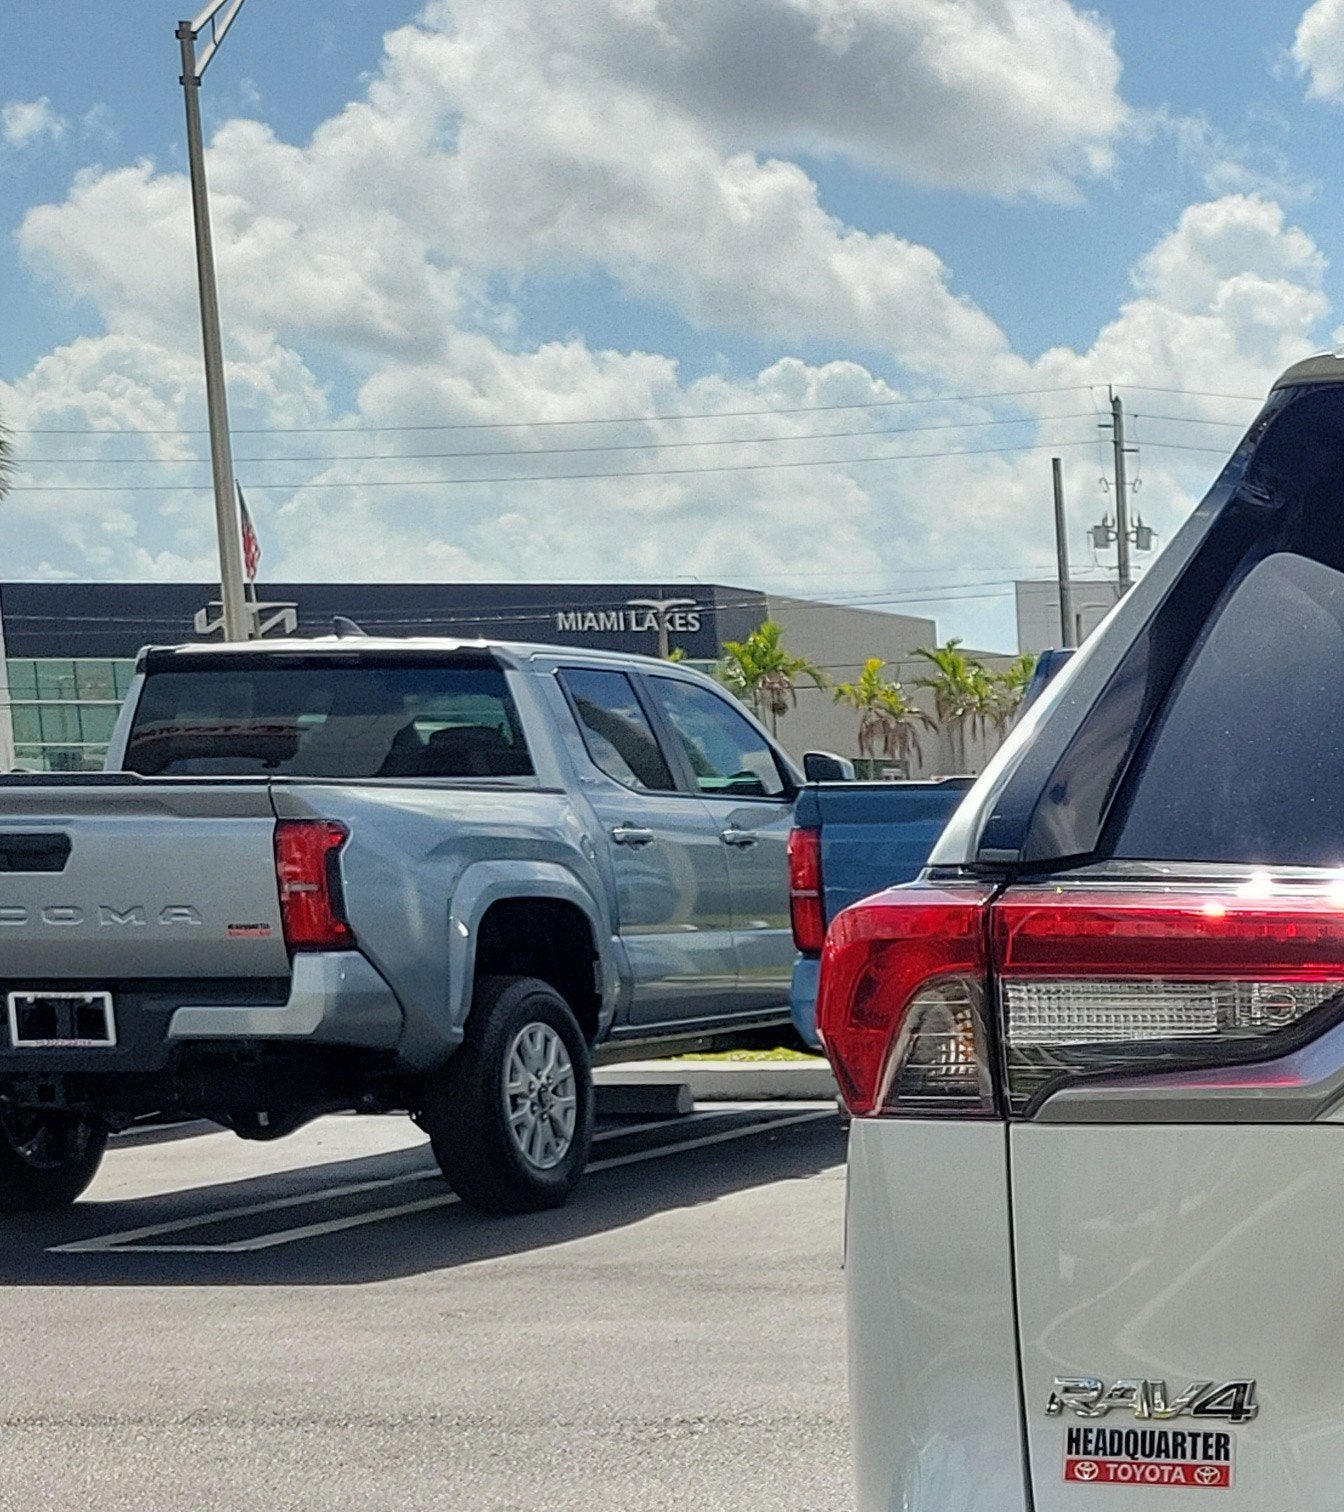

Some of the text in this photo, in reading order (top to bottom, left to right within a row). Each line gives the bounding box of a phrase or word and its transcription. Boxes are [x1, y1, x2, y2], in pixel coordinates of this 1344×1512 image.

[557, 610, 701, 632] MIAMI LAKES
[1044, 1376, 1260, 1425] RAV4
[1066, 1427, 1231, 1462] HEADQUARTER
[1106, 1463, 1187, 1484] TOYOTA
